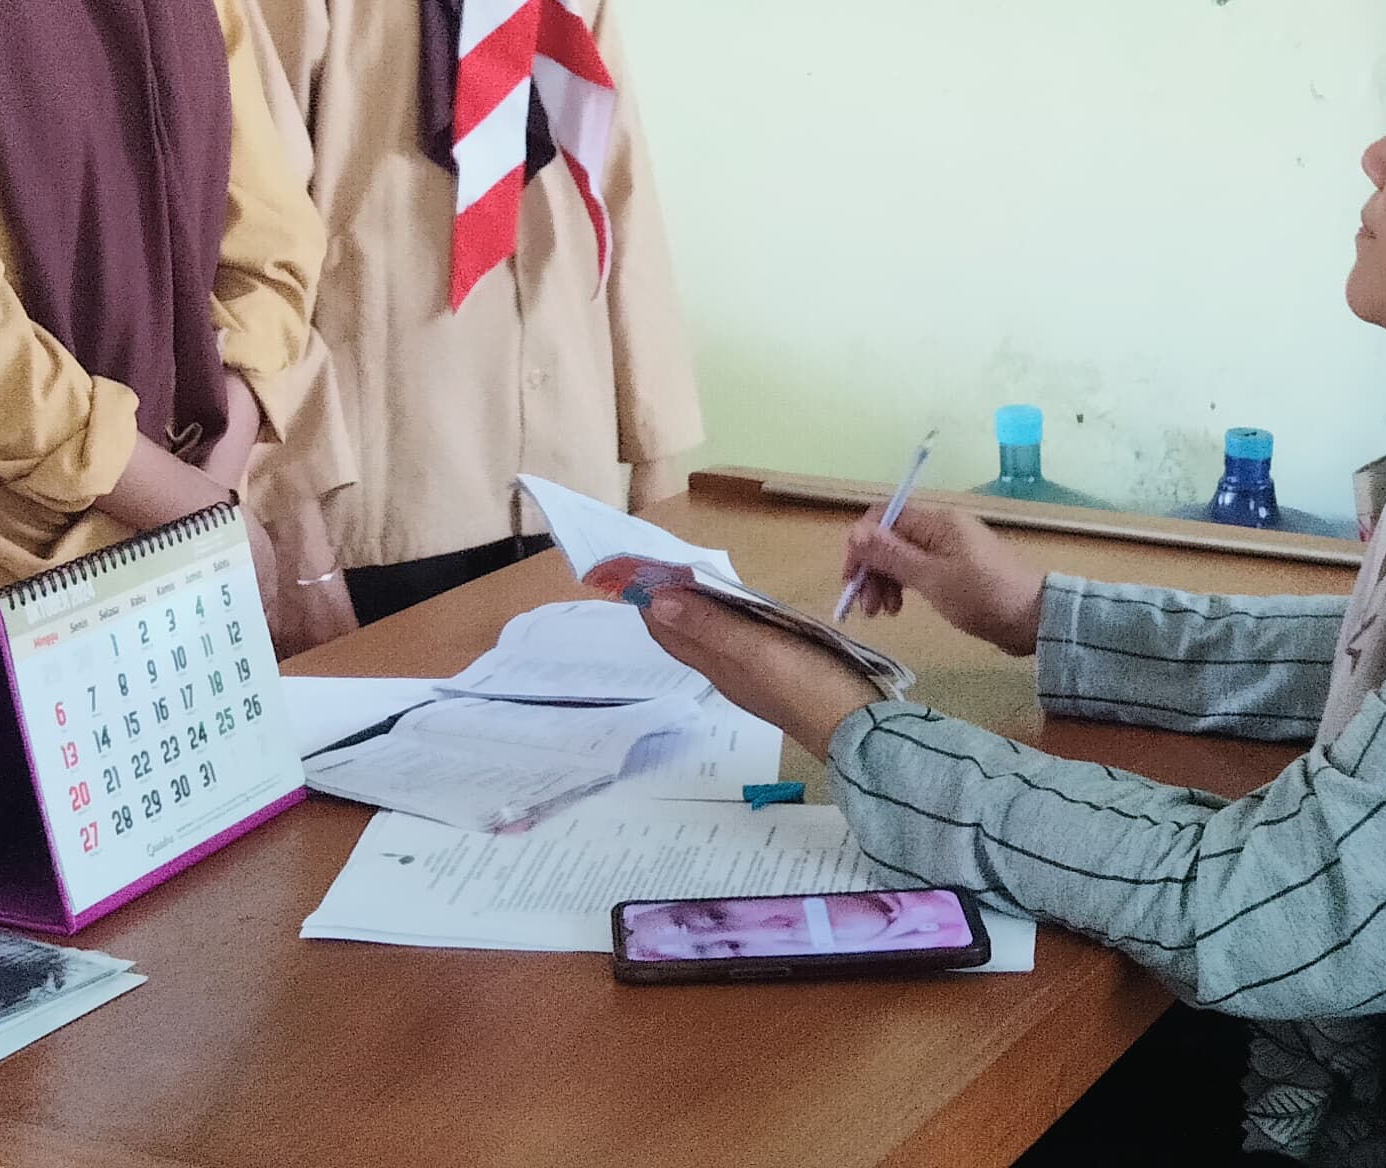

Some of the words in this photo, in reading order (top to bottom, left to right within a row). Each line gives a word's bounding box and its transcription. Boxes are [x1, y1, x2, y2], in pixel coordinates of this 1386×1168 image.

[99, 606, 120, 621] Selasa
[130, 594, 147, 608] Rabu
[156, 583, 175, 597] Kamis
[110, 633, 119, 657] 1
[139, 620, 149, 644] 2
[166, 608, 176, 632] 3
[195, 595, 205, 618] 4
[221, 584, 231, 607] 5
[55, 701, 66, 726] 6
[87, 686, 97, 713] 7
[118, 673, 129, 696] 8
[147, 659, 157, 684] 9
[171, 646, 187, 672] 10
[201, 633, 214, 658] 11
[226, 621, 242, 645] 12
[61, 742, 78, 769] 13
[93, 725, 111, 753] 14
[124, 710, 140, 738] 15
[152, 697, 169, 724] 16
[180, 684, 194, 710] 17
[208, 670, 224, 696] 18
[235, 658, 251, 683] 19
[69, 781, 91, 811] 20
[103, 766, 121, 794] 21
[131, 750, 152, 779] 22
[160, 735, 180, 764] 23
[187, 721, 208, 750] 24
[216, 707, 235, 736] 25
[243, 693, 262, 722] 26
[80, 821, 98, 852] 27
[112, 805, 133, 835] 28
[142, 789, 162, 819] 29
[170, 774, 191, 803] 30
[199, 760, 216, 788] 31
